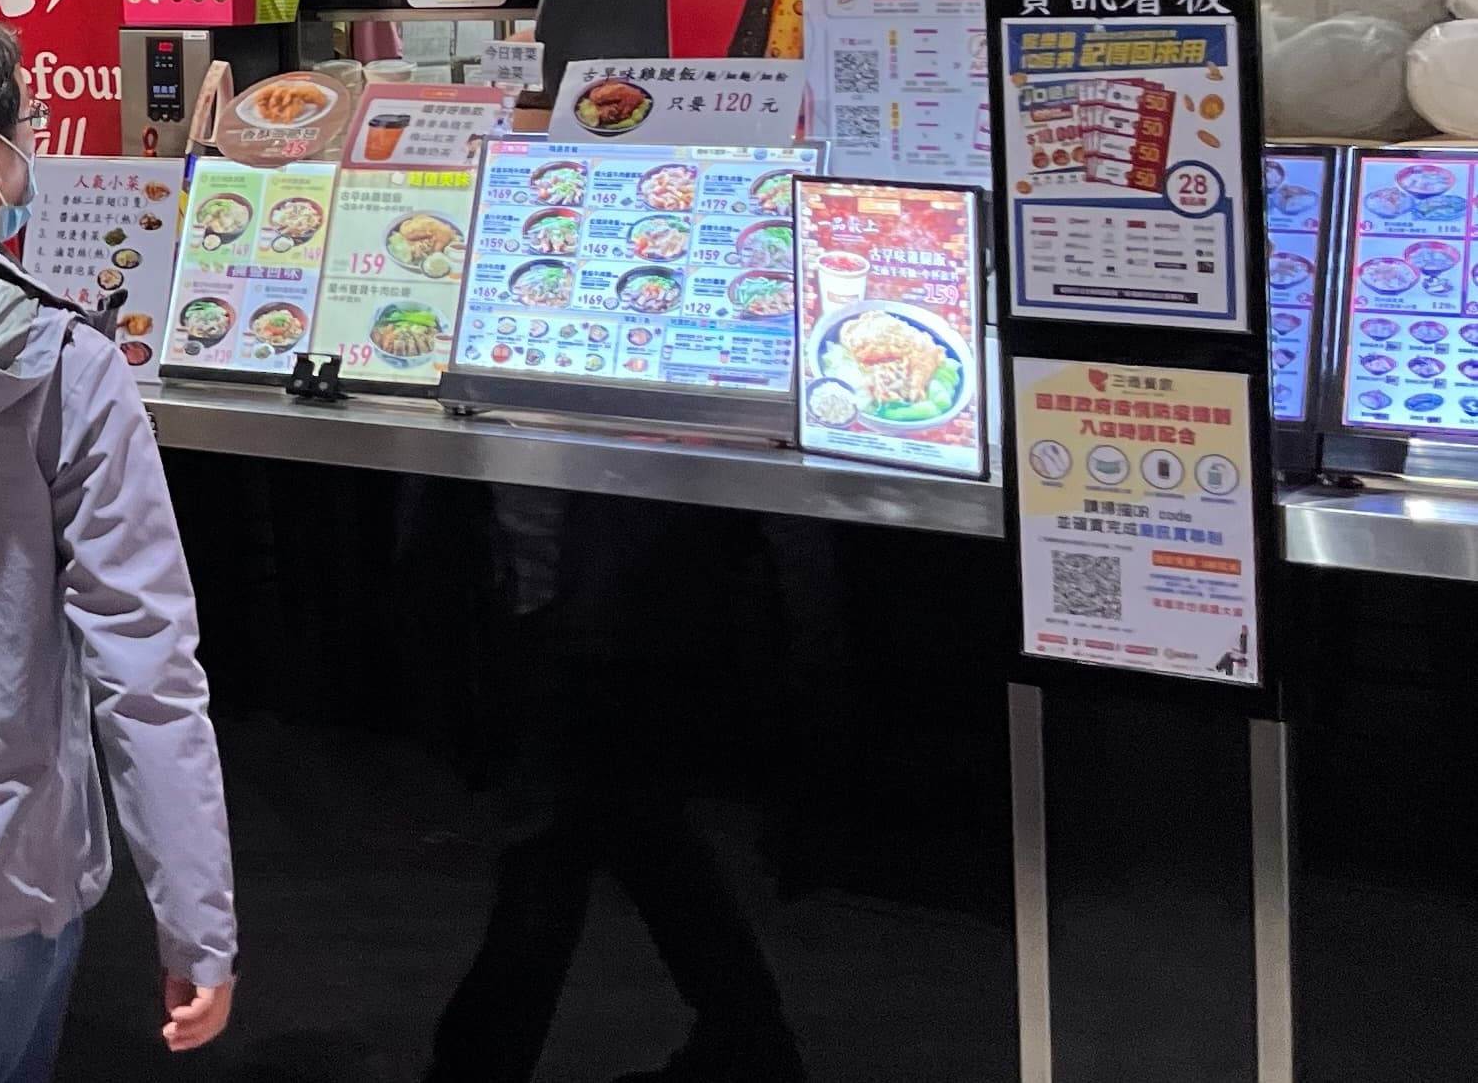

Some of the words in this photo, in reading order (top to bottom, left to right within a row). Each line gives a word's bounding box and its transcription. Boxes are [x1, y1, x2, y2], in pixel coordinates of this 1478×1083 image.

[485, 45, 537, 62] 今日青菜
[667, 96, 706, 112] 只要
[714, 92, 753, 112] 120
[759, 98, 780, 113] 元
[74, 175, 141, 191] 人氣小菜
[1178, 173, 1208, 195] 28
[349, 252, 387, 274] 159
[924, 282, 960, 306] 159
[337, 343, 374, 366] 159
